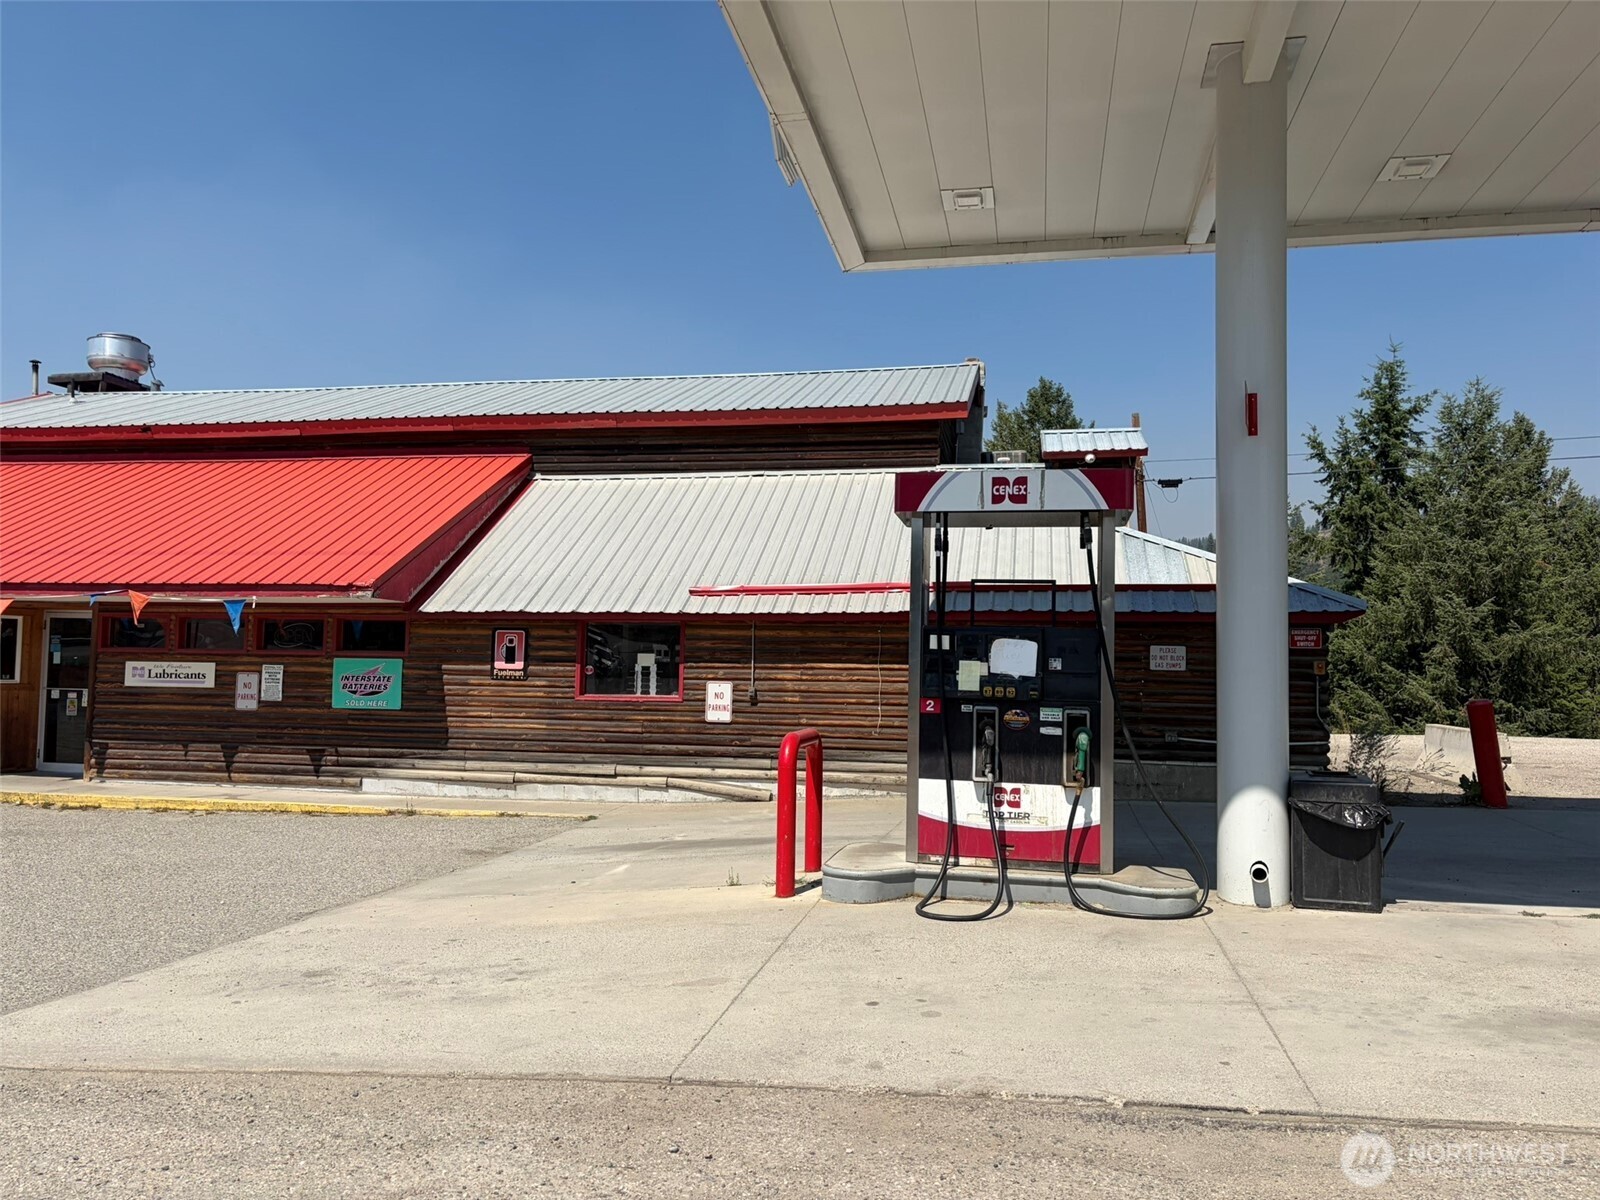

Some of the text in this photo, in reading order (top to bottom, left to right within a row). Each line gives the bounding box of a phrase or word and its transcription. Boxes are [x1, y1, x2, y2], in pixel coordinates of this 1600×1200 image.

[992, 485, 1027, 495] CENEX
[147, 668, 207, 680] Lubricants
[340, 675, 393, 683] INTERSTATE
[243, 682, 252, 690] NO
[341, 683, 389, 691] BATTERIES
[237, 693, 257, 701] PARKING
[714, 691, 725, 700] NO
[345, 699, 365, 707] SOLD
[708, 703, 730, 712] PARKING
[925, 700, 935, 711] 2
[995, 793, 1021, 802] CENEX
[1007, 811, 1031, 820] TIER
